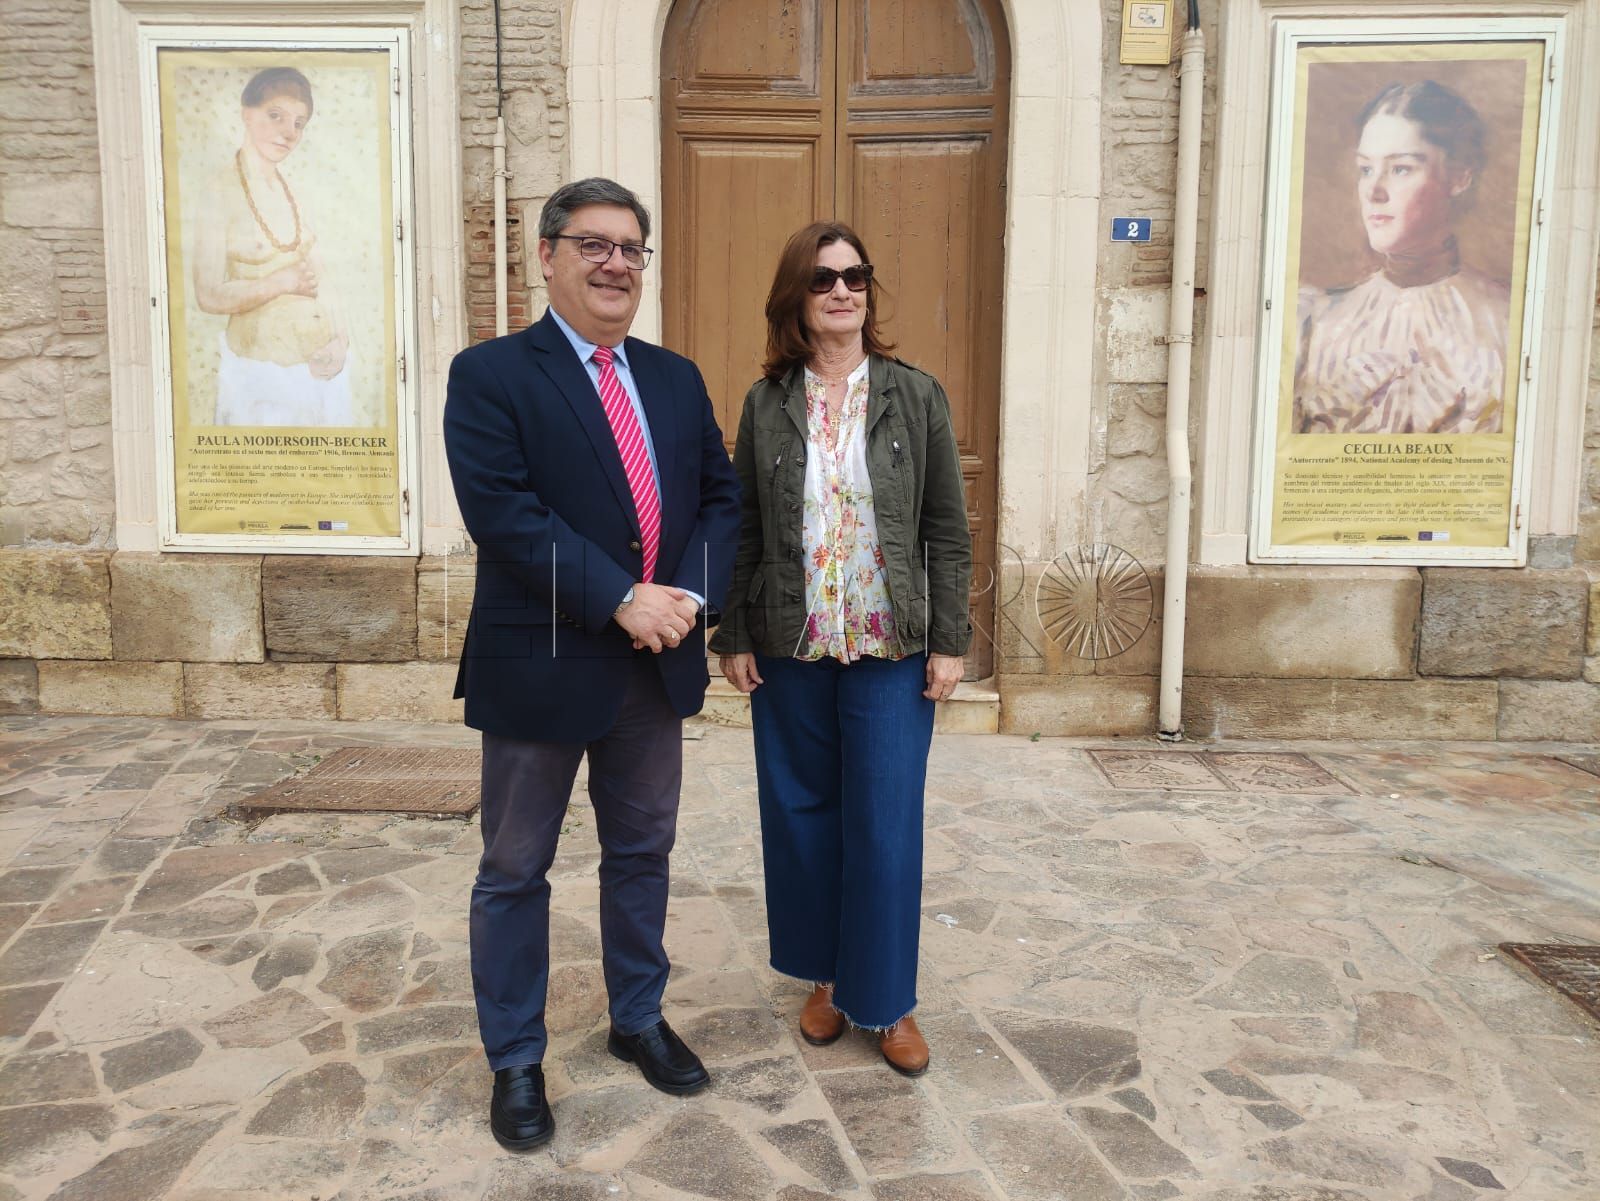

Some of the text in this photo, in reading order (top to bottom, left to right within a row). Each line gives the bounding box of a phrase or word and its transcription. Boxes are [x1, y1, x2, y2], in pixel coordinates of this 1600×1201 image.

[1127, 221, 1139, 238] 2
[197, 436, 388, 447] PAULA MODERSOHN-BECKER
[1343, 444, 1453, 454] CECILIA BEAUX
[1359, 456, 1389, 464] National
[1390, 456, 1420, 465] Academy
[1422, 456, 1430, 464] of
[1485, 456, 1495, 464] de
